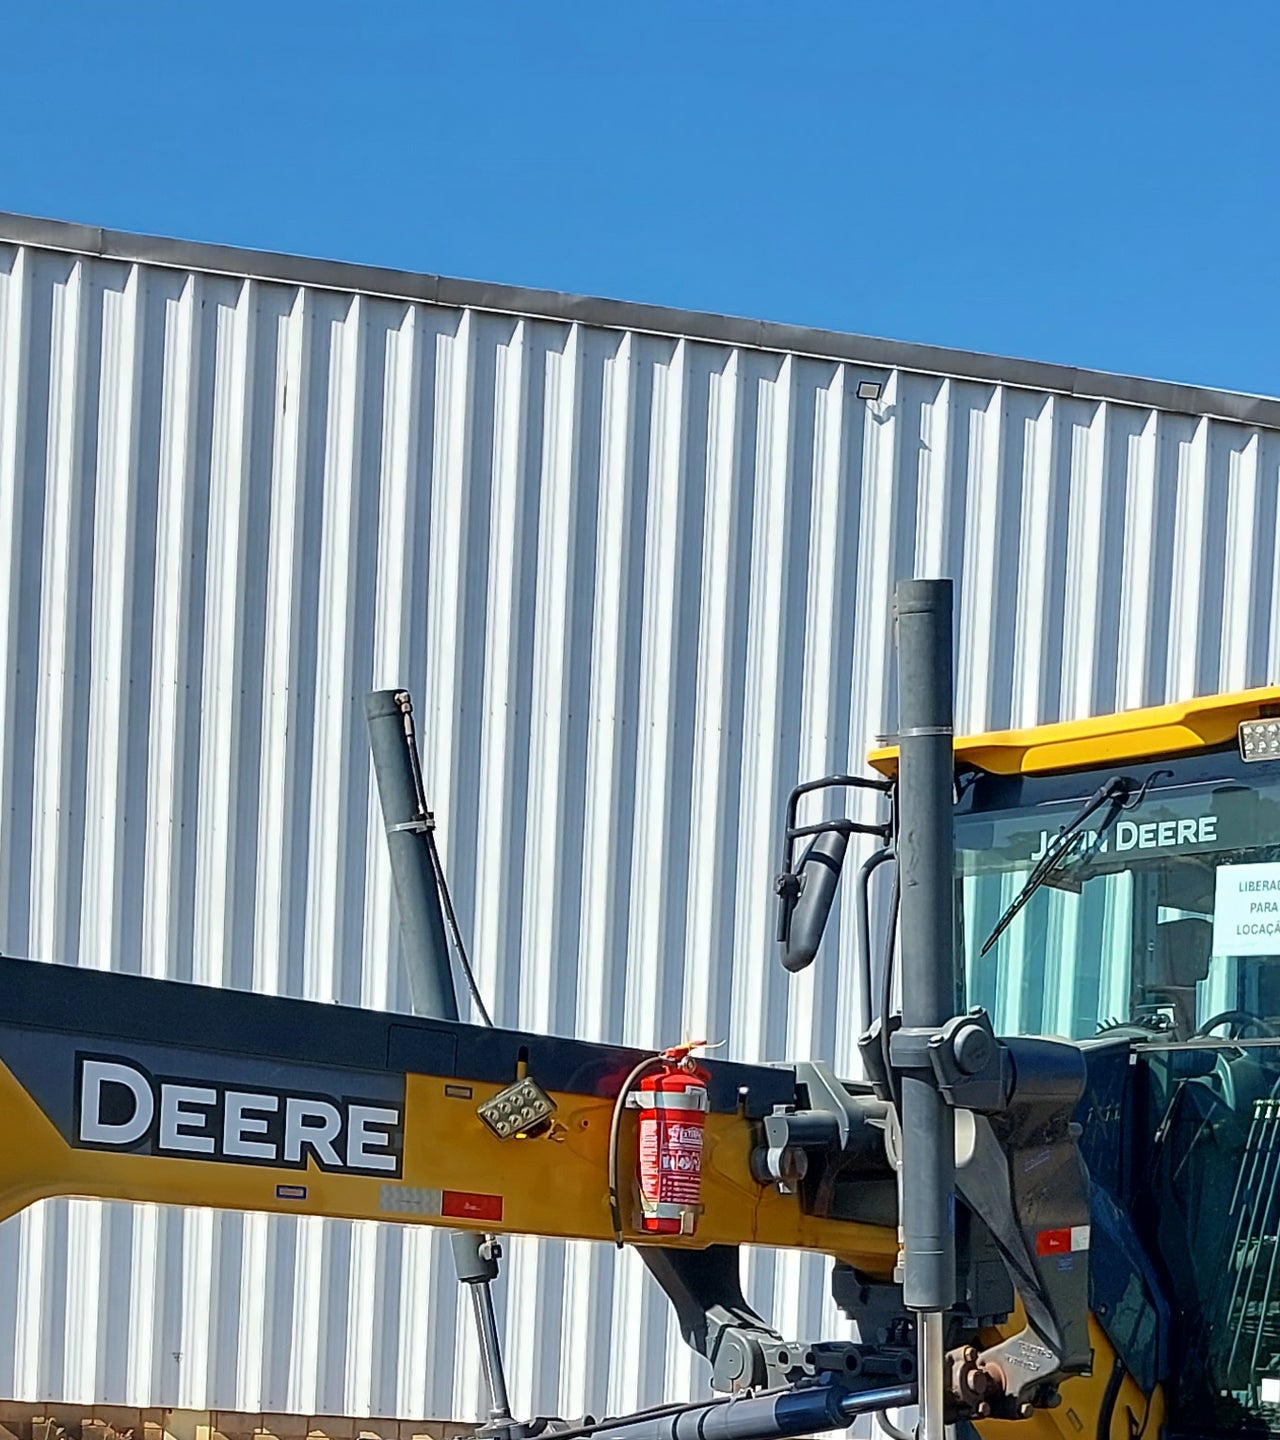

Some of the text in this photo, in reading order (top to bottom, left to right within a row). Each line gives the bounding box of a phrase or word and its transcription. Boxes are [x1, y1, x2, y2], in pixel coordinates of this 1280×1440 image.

[1031, 816, 1218, 861] JON DEERE
[1249, 902, 1279, 914] PARA
[79, 1060, 399, 1171] DEERE
